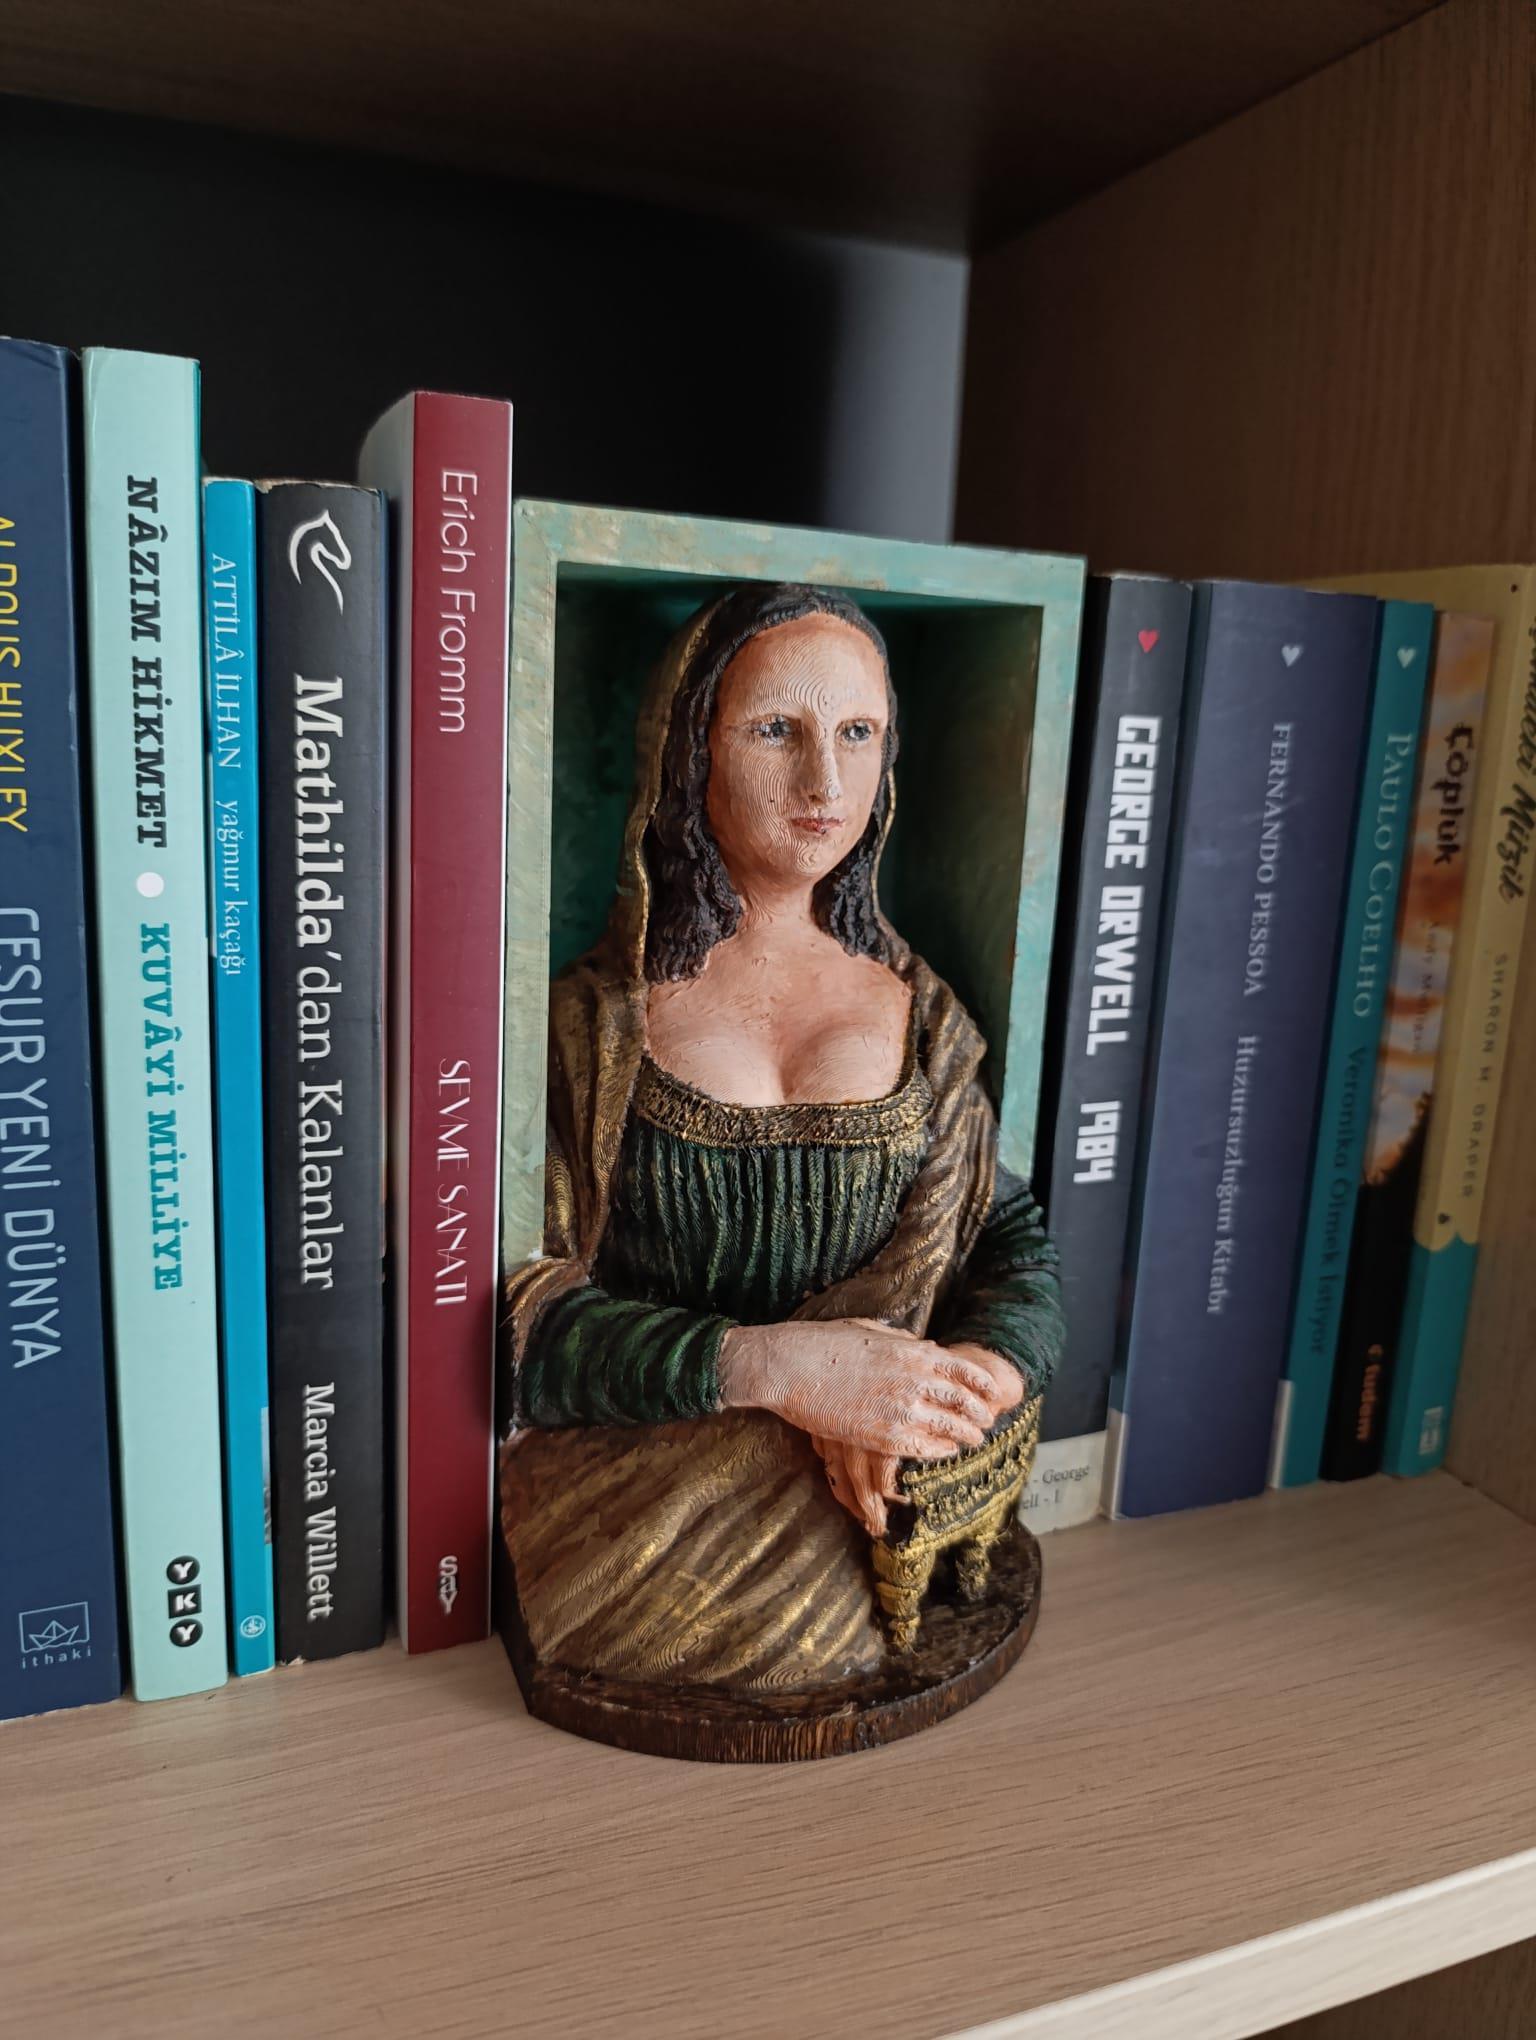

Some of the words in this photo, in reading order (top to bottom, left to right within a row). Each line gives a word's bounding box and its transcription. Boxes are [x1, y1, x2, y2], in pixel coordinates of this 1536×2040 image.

[127, 475, 168, 642] NÂZIM
[439, 467, 477, 574] Erich
[438, 587, 476, 734] Fromm
[132, 656, 173, 848] HİKMET
[215, 672, 242, 769] İLHAN
[216, 799, 246, 891] yağmur
[1105, 715, 1161, 869] GEORGE
[1256, 721, 1293, 884] FERNANDO
[1373, 733, 1412, 852] PAULO
[0, 907, 46, 1064] CESUR
[219, 899, 248, 976] kaçağı
[1086, 885, 1144, 1056] ORWELL
[1243, 892, 1273, 998] PESSOA
[1352, 861, 1393, 1018] COELHO
[140, 923, 184, 1097] KUVÂYİ
[1482, 953, 1507, 1055] SHARON
[0, 1077, 61, 1190] YENİ
[437, 1057, 471, 1172] SEVME
[1072, 1100, 1122, 1183] 1984
[1214, 1034, 1258, 1232] Huzursuzluğun
[1461, 1103, 1484, 1199] DRAPER
[148, 1110, 190, 1290] MİLLİYE
[299, 1079, 344, 1290] Kalanlar
[4, 1208, 66, 1369] DÜNYA
[434, 1183, 469, 1306] SANATI
[1206, 1237, 1235, 1315] Kitabı
[303, 1381, 336, 1500] Marcia
[305, 1506, 337, 1623] Willett
[22, 1645, 91, 1669] ithaki
